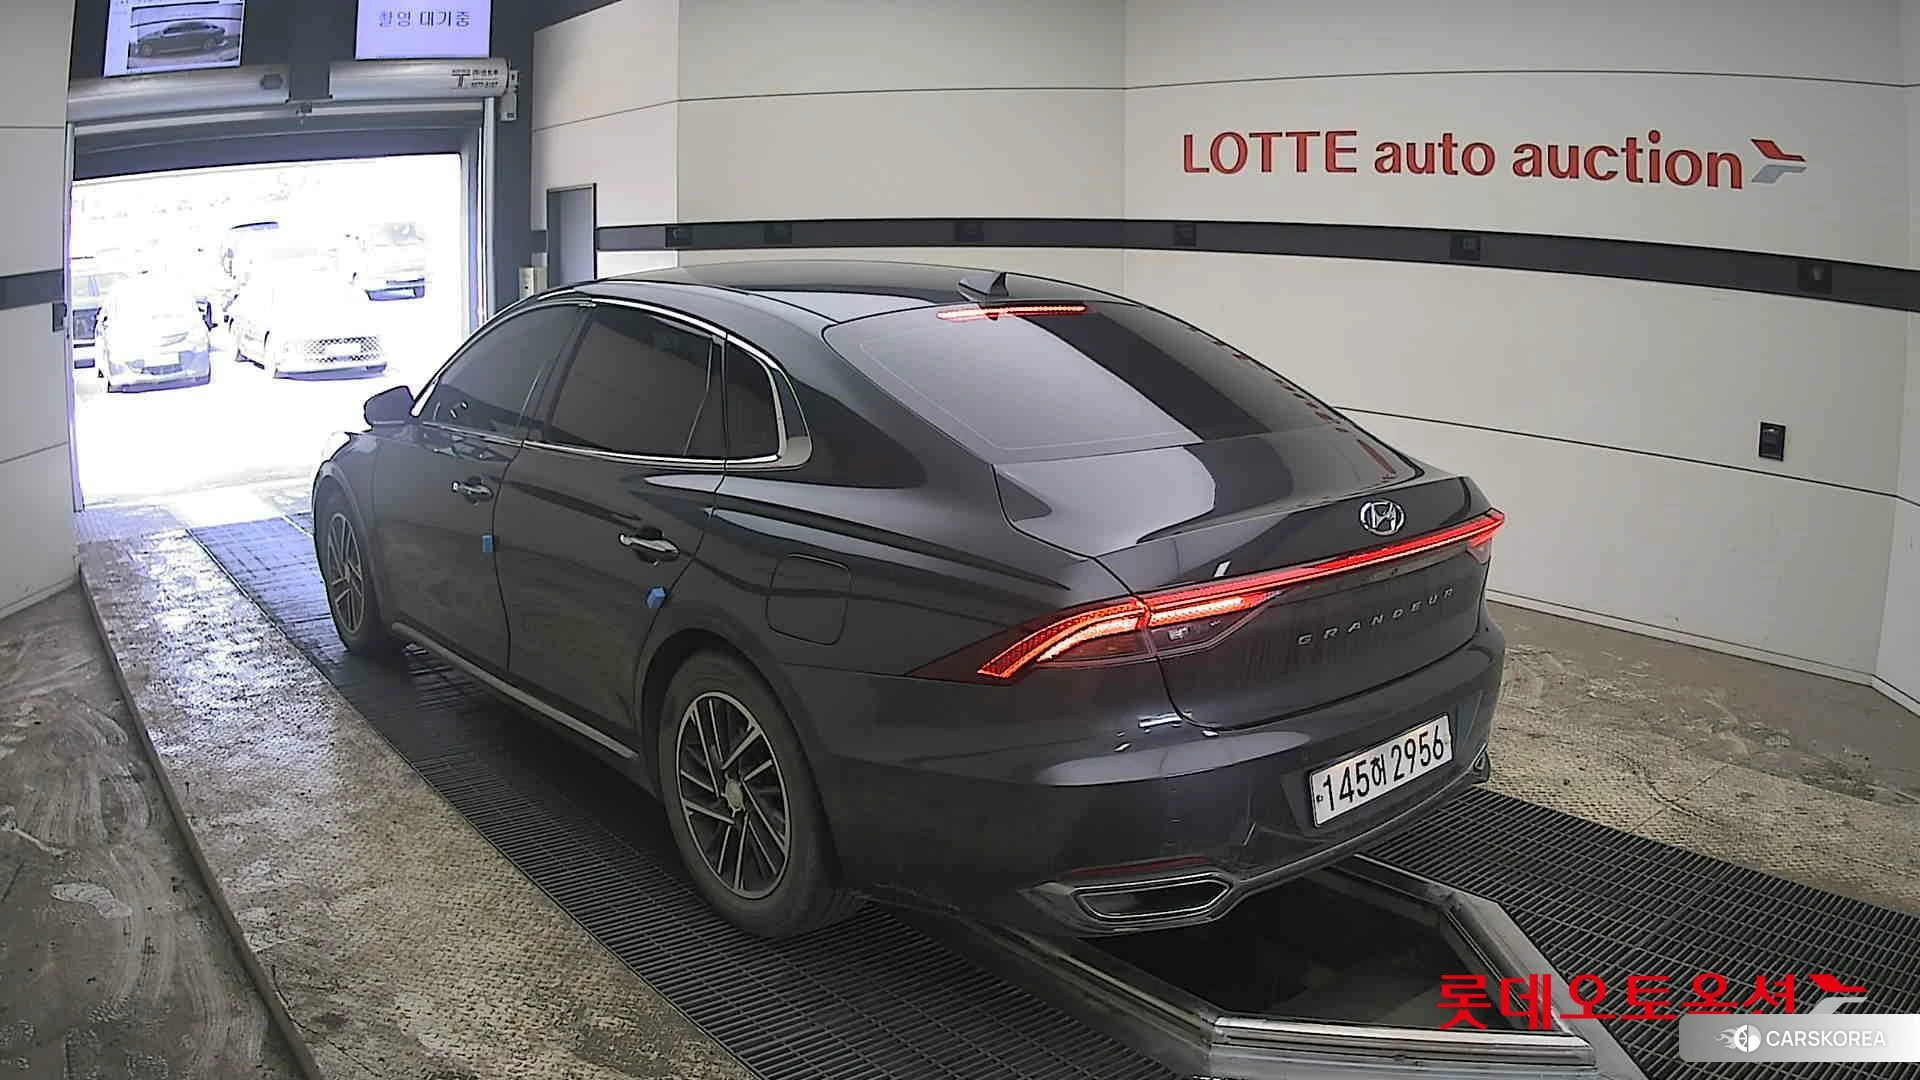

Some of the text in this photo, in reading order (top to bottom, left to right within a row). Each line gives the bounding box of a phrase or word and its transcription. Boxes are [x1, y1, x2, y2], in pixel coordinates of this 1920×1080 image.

[420, 11, 470, 28] 대기중
[1184, 129, 1744, 190] LOTTE auto auction
[1298, 588, 1453, 645] GRANDEUR
